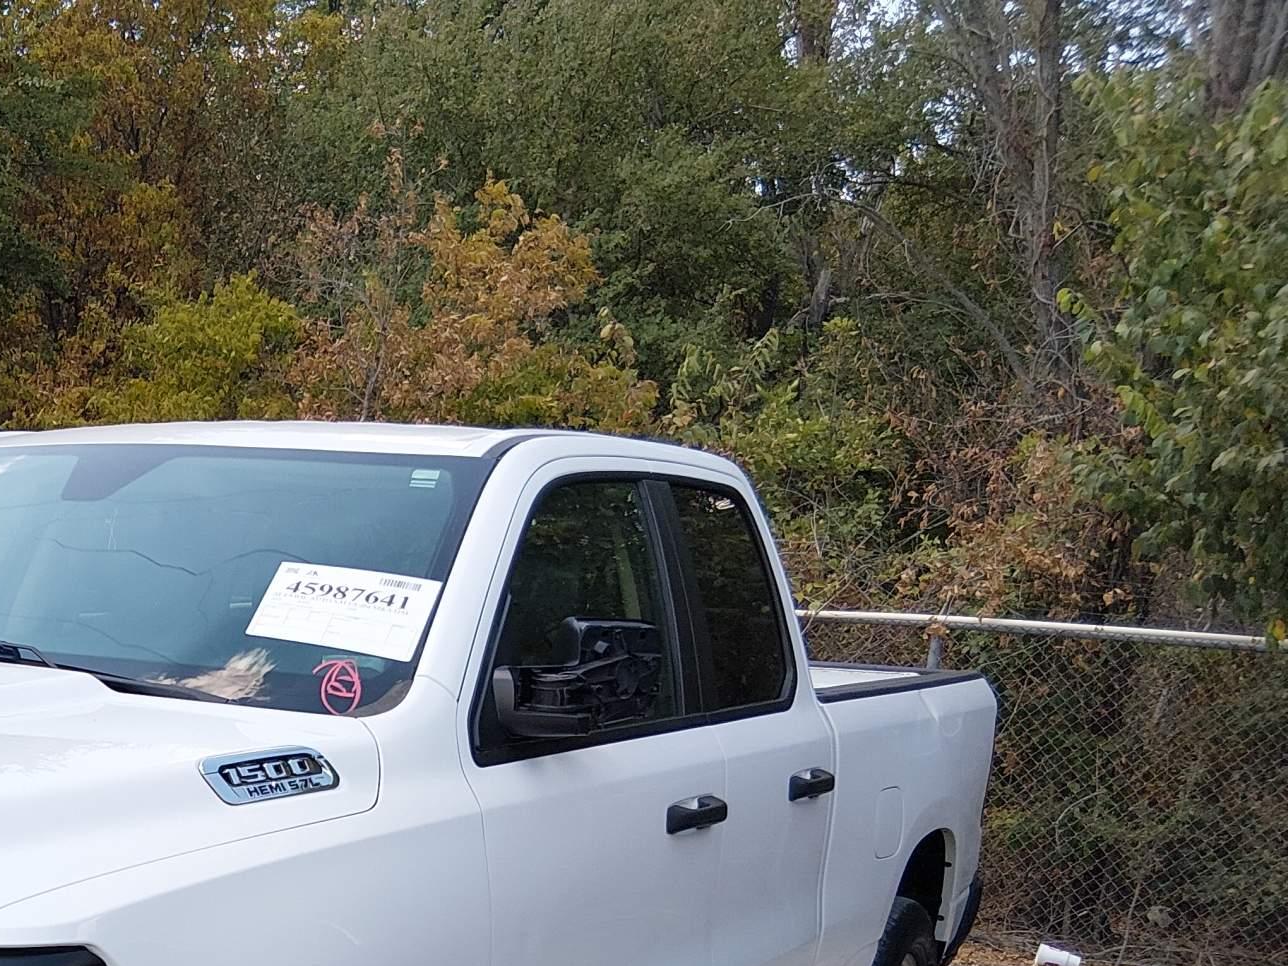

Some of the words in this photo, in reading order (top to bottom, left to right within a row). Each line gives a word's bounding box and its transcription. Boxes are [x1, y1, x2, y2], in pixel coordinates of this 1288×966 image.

[285, 580, 410, 610] 45987641
[223, 757, 310, 785] 1500
[247, 781, 287, 798] HEMI
